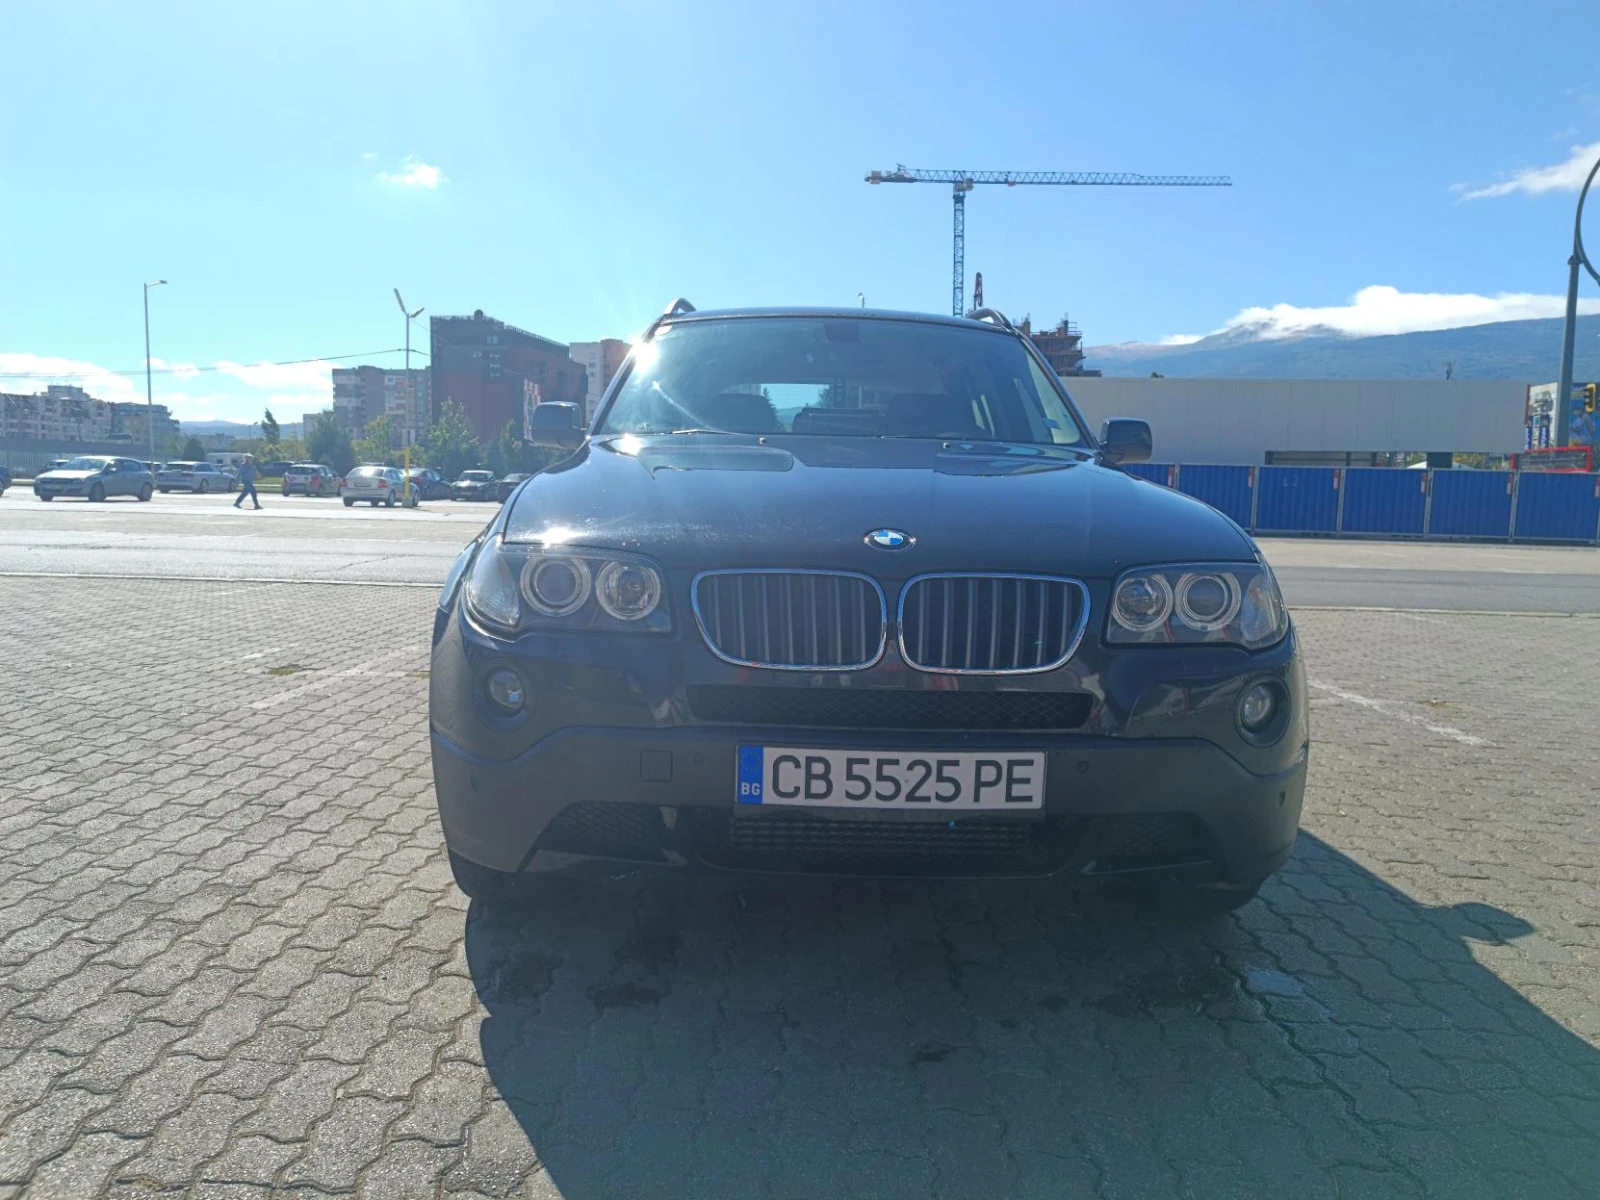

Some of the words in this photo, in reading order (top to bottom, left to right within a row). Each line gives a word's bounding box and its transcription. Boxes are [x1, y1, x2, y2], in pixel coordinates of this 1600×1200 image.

[741, 782, 760, 796] BG
[772, 755, 833, 800] CB
[845, 757, 962, 802] 5525
[973, 759, 1034, 803] PE
